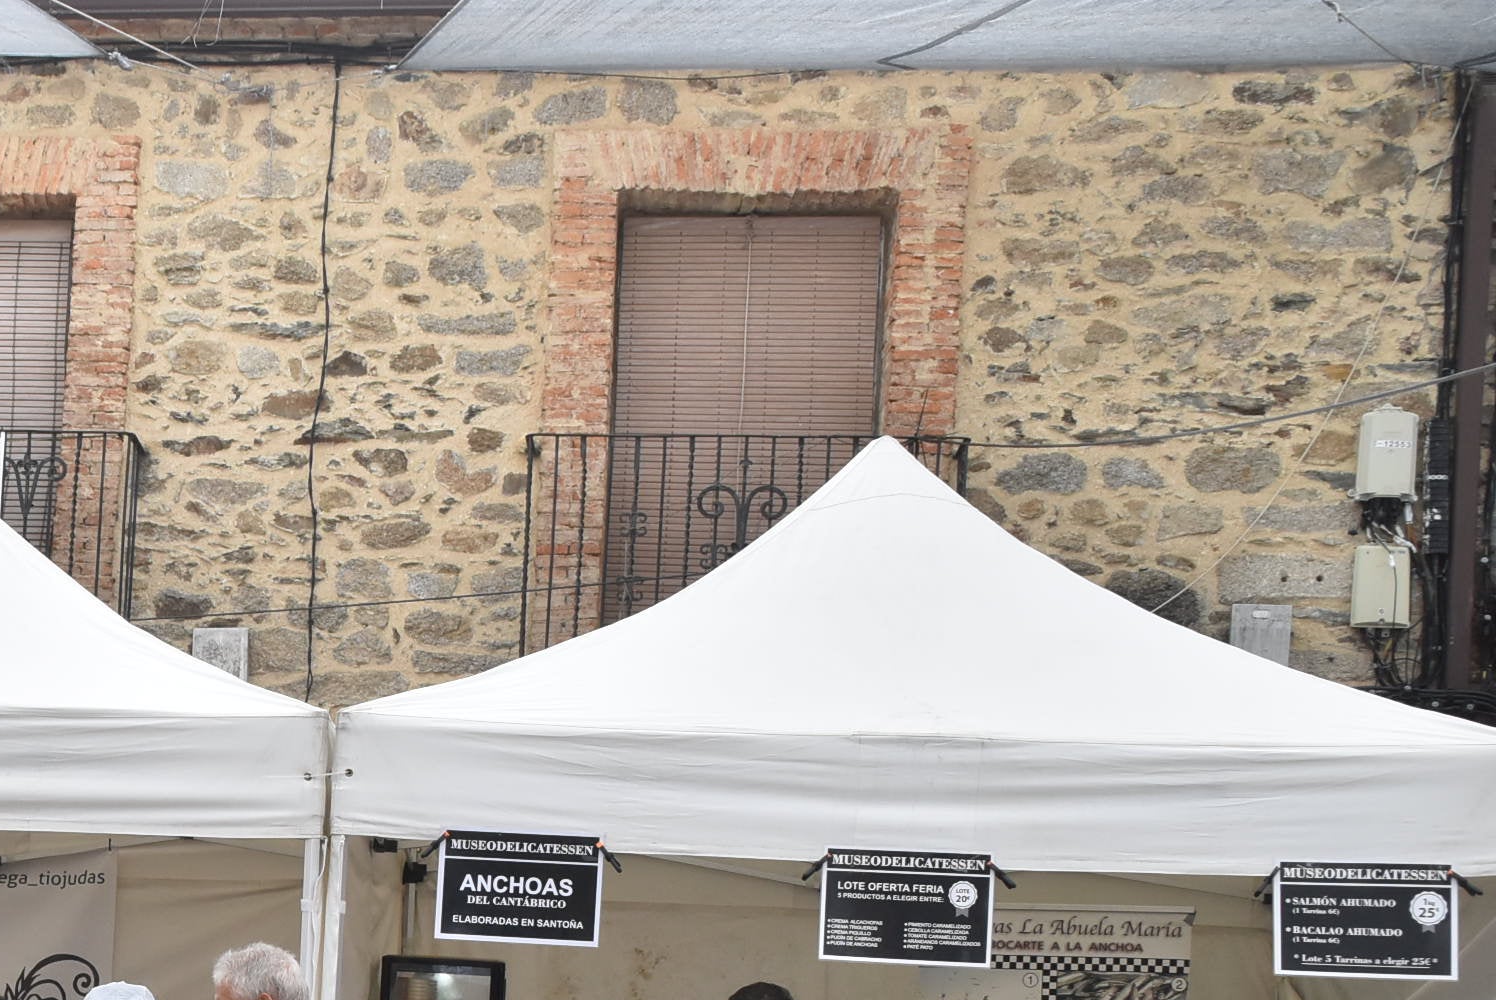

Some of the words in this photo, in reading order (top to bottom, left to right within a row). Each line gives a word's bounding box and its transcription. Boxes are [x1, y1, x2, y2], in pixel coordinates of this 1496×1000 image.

[451, 839, 594, 856] MUSEODELICATESSEN
[832, 854, 986, 871] MUSEODELICATESSEN
[1284, 867, 1447, 881] MUSEODELICATESSEN
[459, 874, 574, 897] ANCHOAS
[837, 881, 865, 890] LOTE
[868, 882, 910, 892] OFERTA
[913, 884, 944, 894] FERIA
[467, 895, 490, 905] DEL
[493, 896, 566, 909] CANTÁBRICO
[1292, 896, 1336, 906] SALMÓN
[1339, 898, 1396, 907] AHUMADO
[453, 914, 518, 926] ELABORADAS
[521, 918, 534, 927] EN
[537, 919, 583, 929] SANTOÑA
[1019, 918, 1043, 935] La
[1051, 916, 1114, 936] Abuela
[1121, 920, 1183, 938] María
[1292, 926, 1343, 936] BACALAO
[1346, 927, 1403, 937] AHUMADO
[1050, 941, 1059, 951] A
[1066, 941, 1082, 951] LA
[1090, 942, 1144, 953] ANCHOA
[1302, 954, 1323, 963] Lote
[1325, 955, 1332, 963] 5
[1411, 958, 1431, 966] 25€
